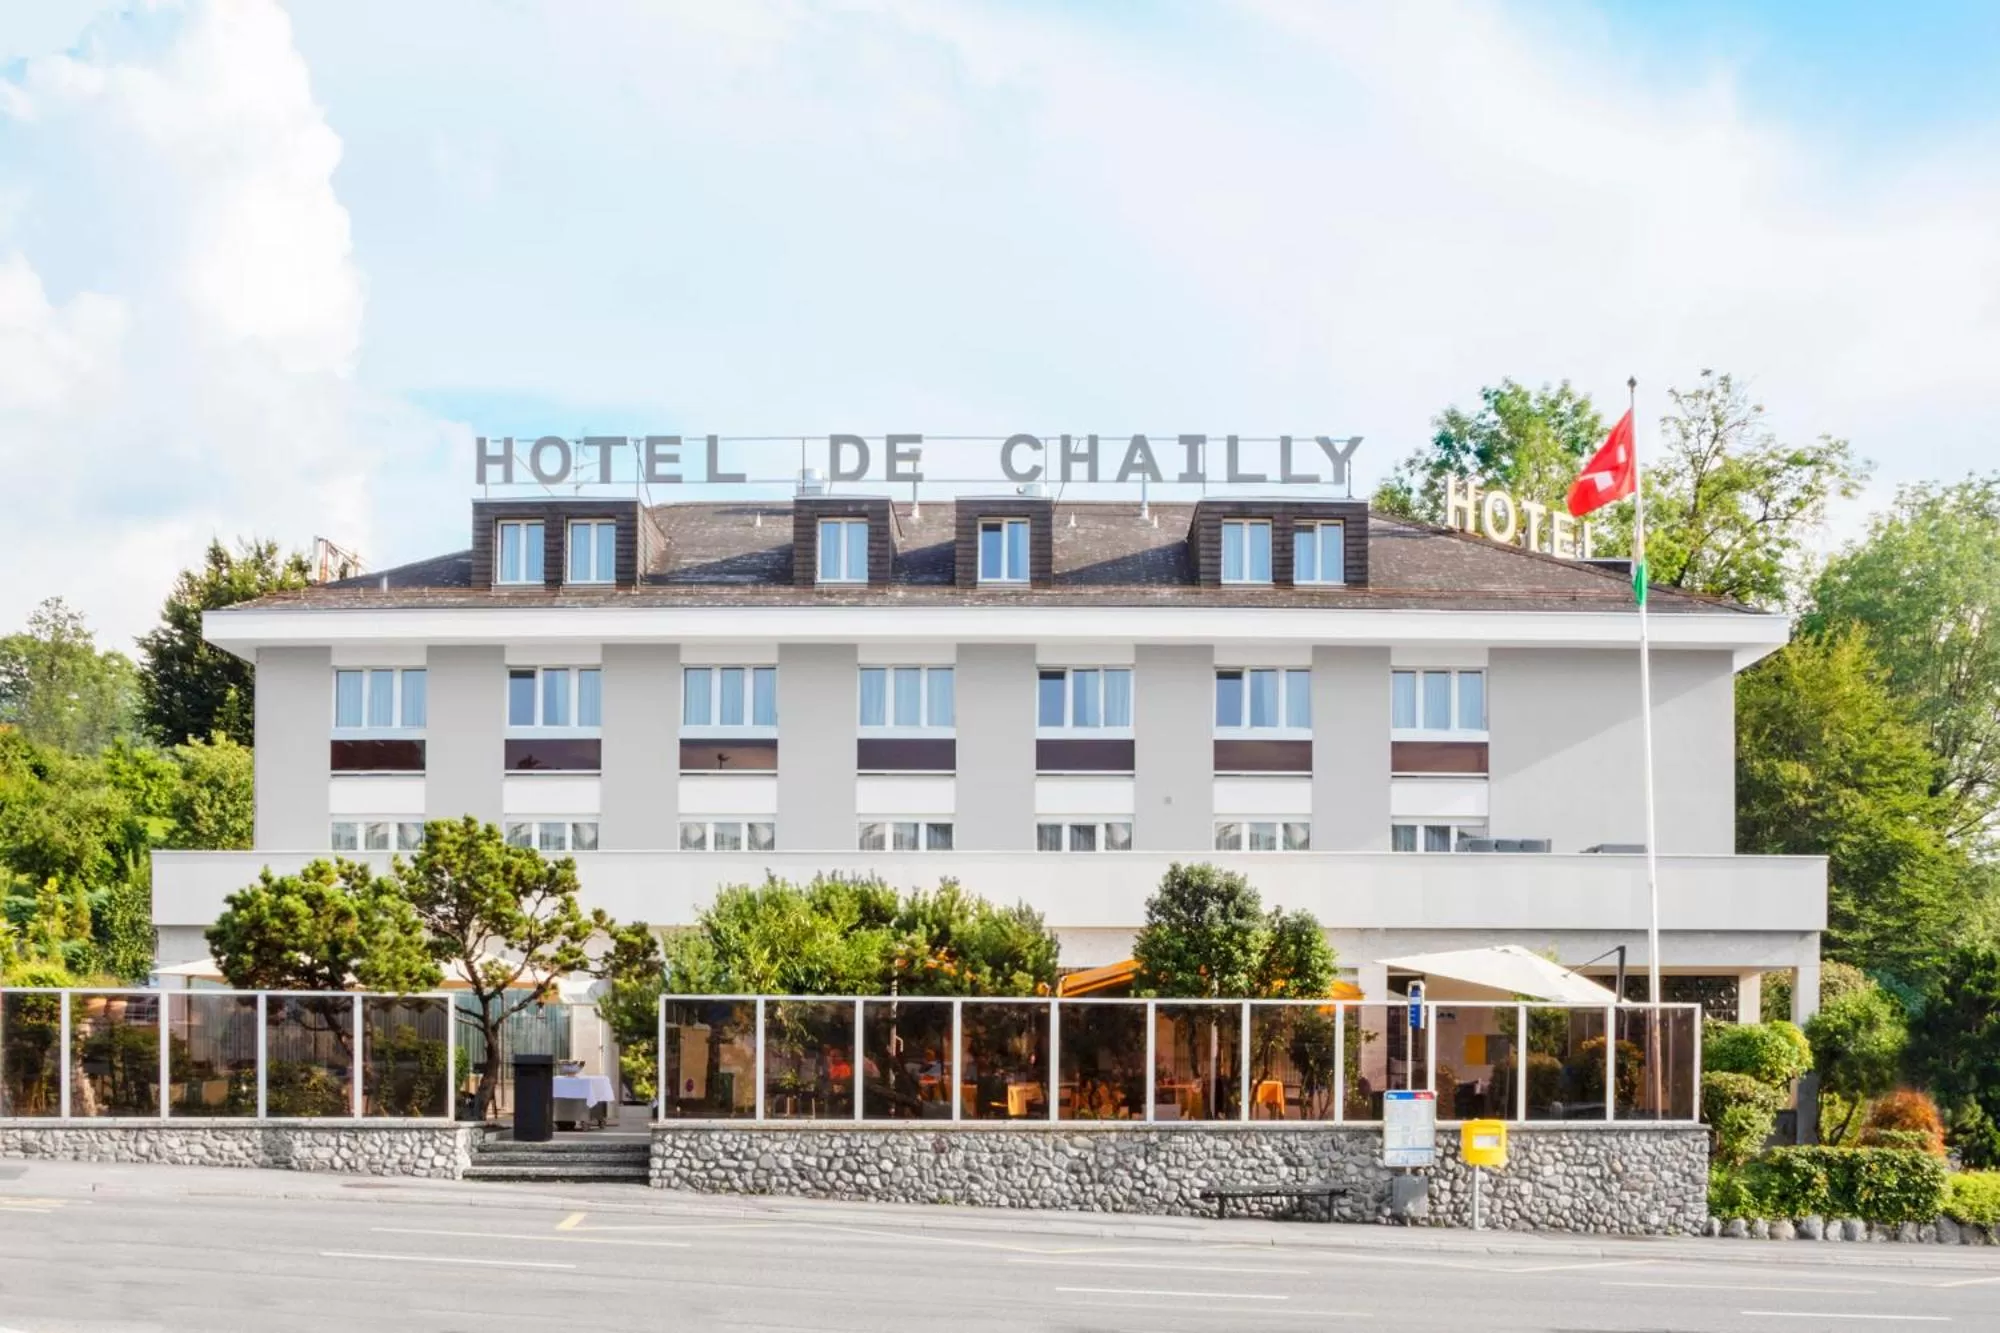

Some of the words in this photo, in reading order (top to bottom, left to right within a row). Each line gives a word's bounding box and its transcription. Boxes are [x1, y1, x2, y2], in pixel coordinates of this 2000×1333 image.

[475, 435, 747, 484] HOTEL
[829, 434, 924, 482] DE
[1000, 433, 1365, 484] CHAILLY
